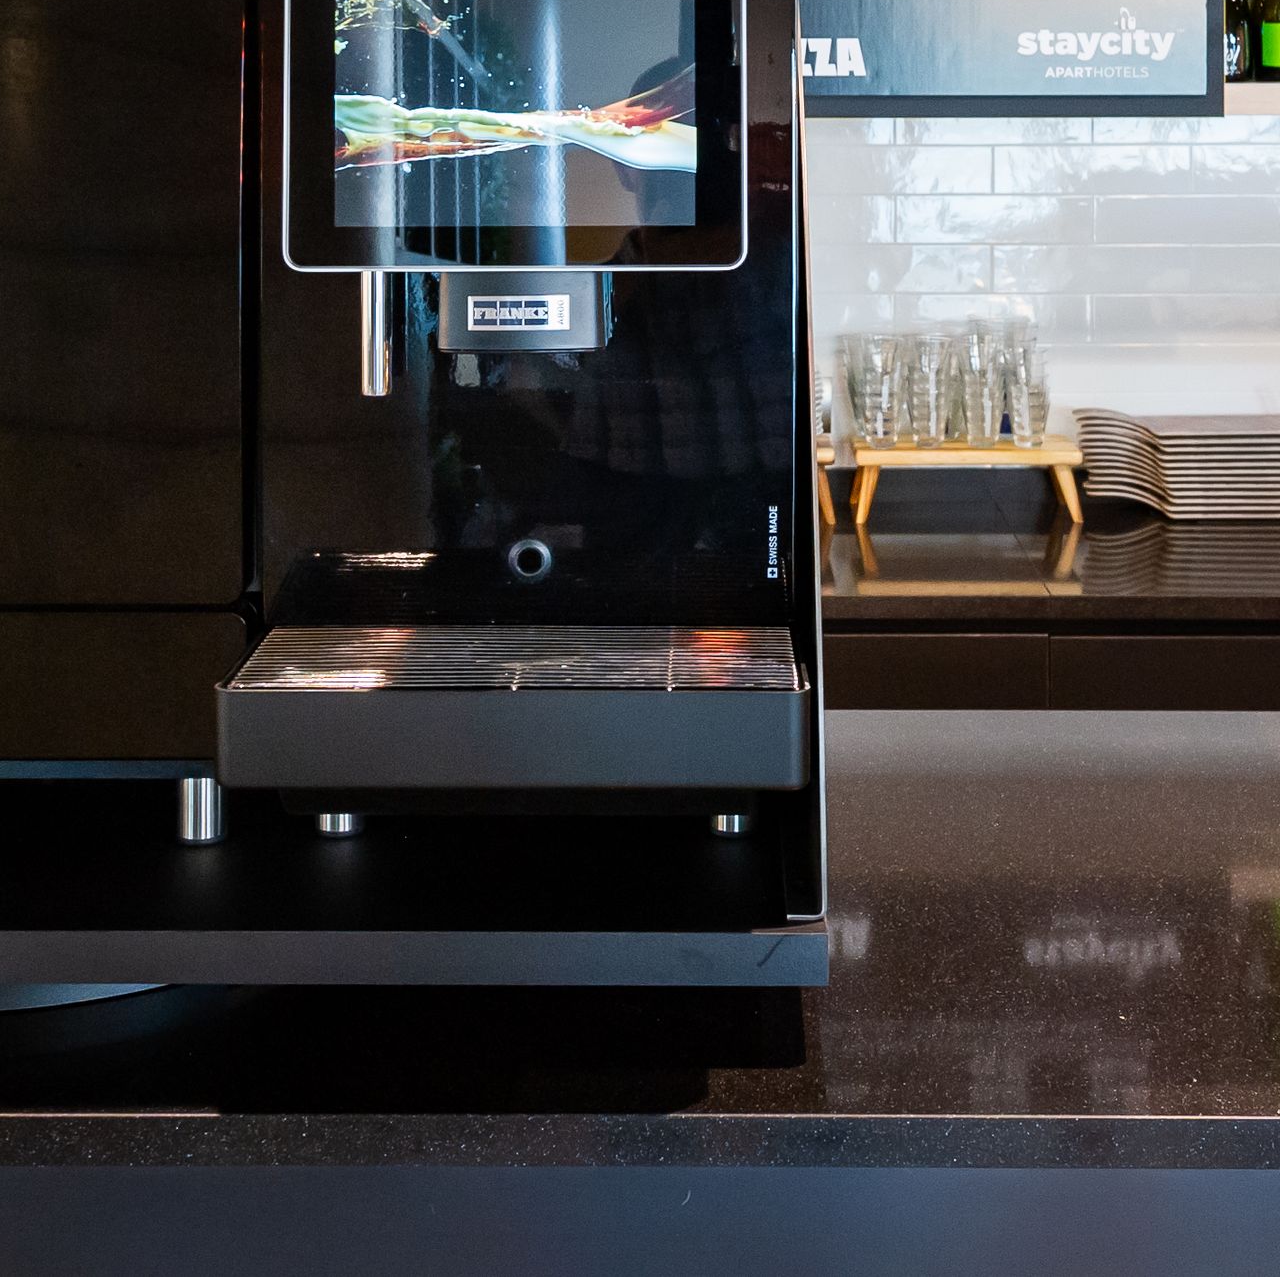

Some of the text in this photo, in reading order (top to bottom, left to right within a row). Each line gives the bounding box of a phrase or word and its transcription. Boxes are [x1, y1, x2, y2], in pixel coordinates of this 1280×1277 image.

[1017, 27, 1176, 61] staycity
[1044, 66, 1151, 79] APARTHOTELS
[473, 306, 549, 320] FRANKE
[768, 505, 778, 565] SWISS MADE
